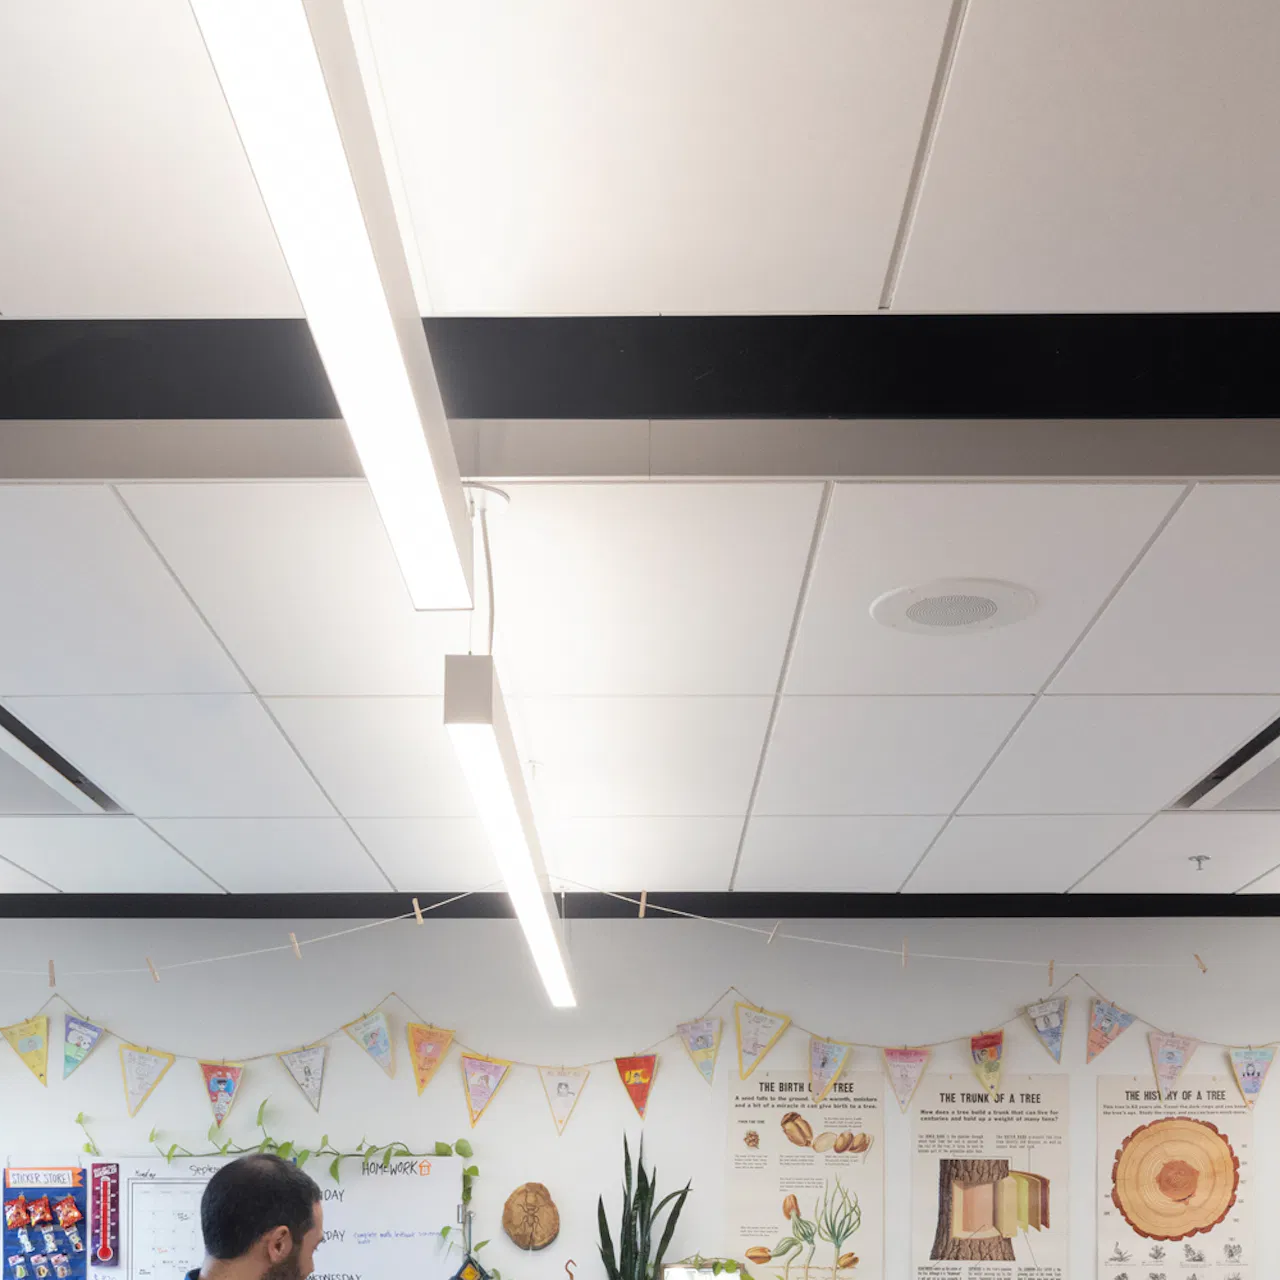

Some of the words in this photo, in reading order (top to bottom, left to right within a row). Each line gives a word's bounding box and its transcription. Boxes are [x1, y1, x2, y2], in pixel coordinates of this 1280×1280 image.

[759, 1082, 775, 1092] THE
[779, 1082, 804, 1092] BIRTH
[833, 1082, 854, 1093] TREE
[940, 1093, 956, 1103] THE
[961, 1093, 989, 1103] TRUNK
[994, 1093, 1004, 1103] OF
[1009, 1093, 1015, 1103] A
[1020, 1093, 1041, 1103] TREE
[1125, 1090, 1140, 1100] THE
[1144, 1090, 1177, 1100] HISTY
[1182, 1090, 1192, 1100] OF
[1196, 1090, 1202, 1100] A
[1207, 1090, 1226, 1100] TREE
[11, 1173, 42, 1184] STICKER
[44, 1172, 70, 1184] STORE!
